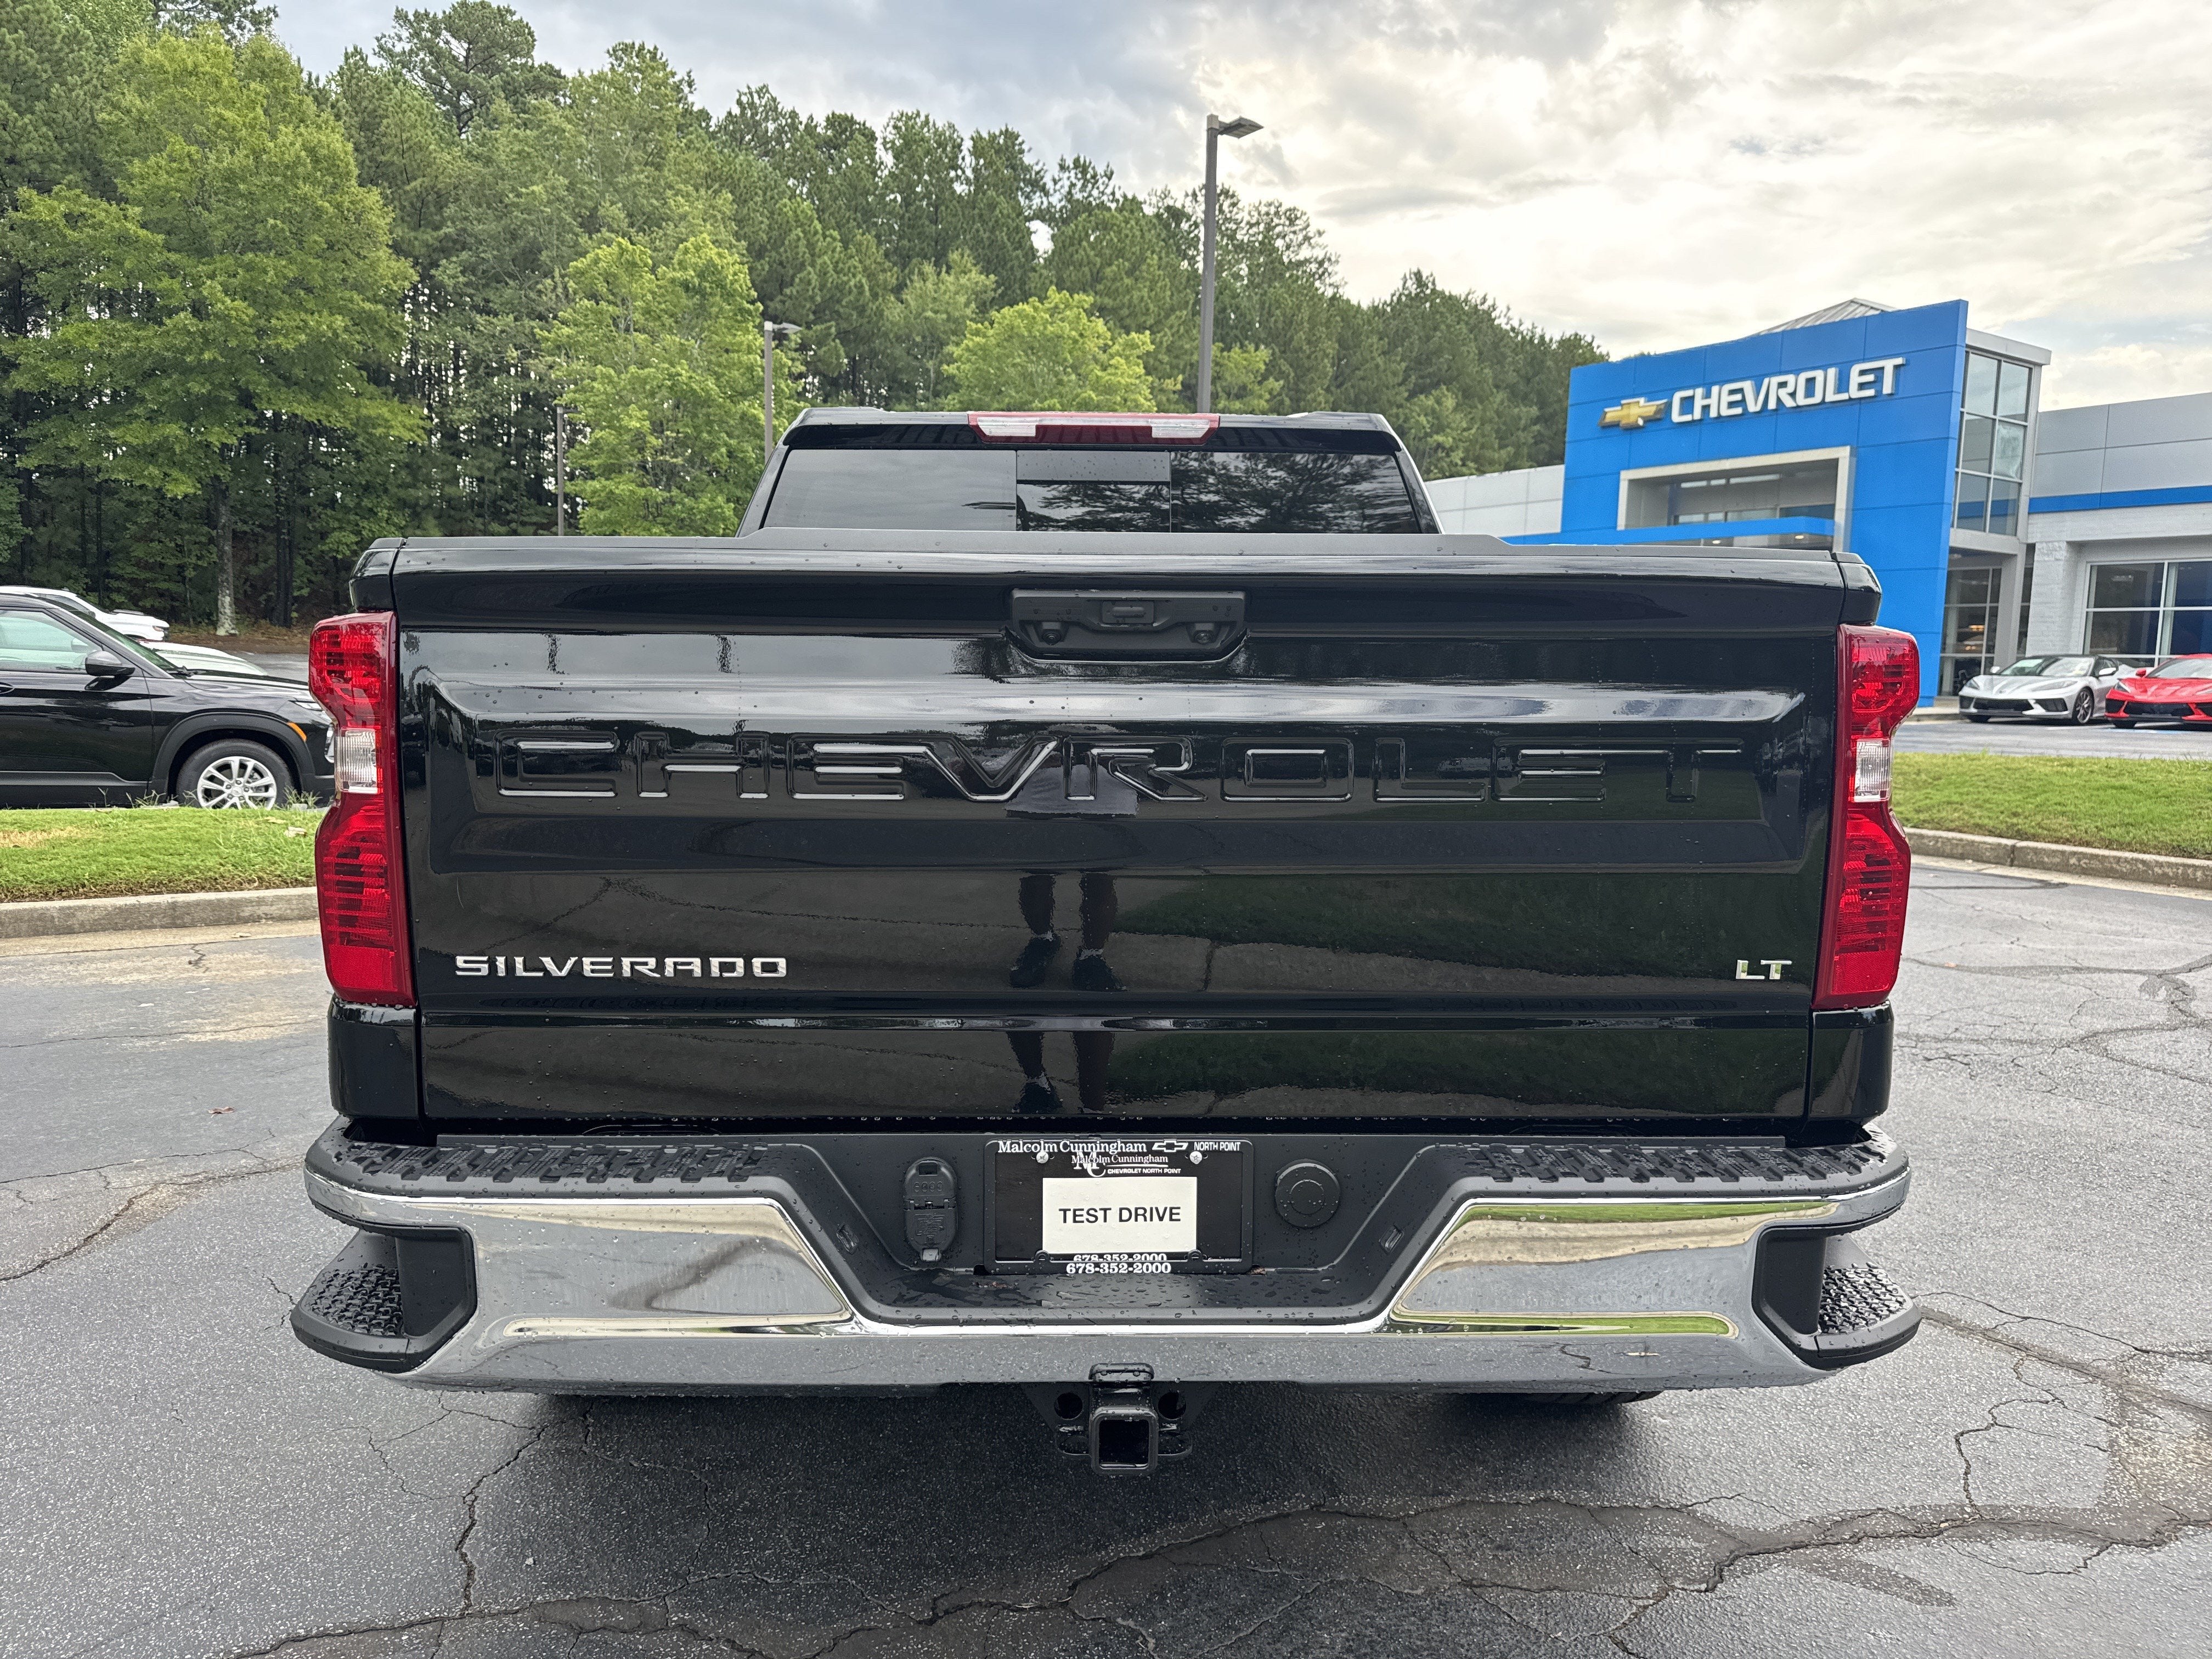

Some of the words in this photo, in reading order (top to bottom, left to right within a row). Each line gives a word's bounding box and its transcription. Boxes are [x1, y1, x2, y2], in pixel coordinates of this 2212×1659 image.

[1671, 357, 1906, 423] CHEVROLET
[493, 730, 1745, 803] CHEVROLET
[455, 955, 788, 978] SILVERADO
[1735, 960, 1792, 980] LT
[998, 1141, 1058, 1153] Malcolm
[1060, 1141, 1147, 1155] Cunningham
[1194, 1142, 1218, 1150] NORTH
[1220, 1142, 1240, 1151] POINT
[1071, 1155, 1110, 1164] Malcolm
[1111, 1154, 1168, 1164] Cunningham
[1059, 1207, 1111, 1223] TEST
[1119, 1207, 1181, 1222] DRIVE
[1073, 1253, 1167, 1261] 678-352-2000
[1066, 1262, 1171, 1274] 678-352-2000
